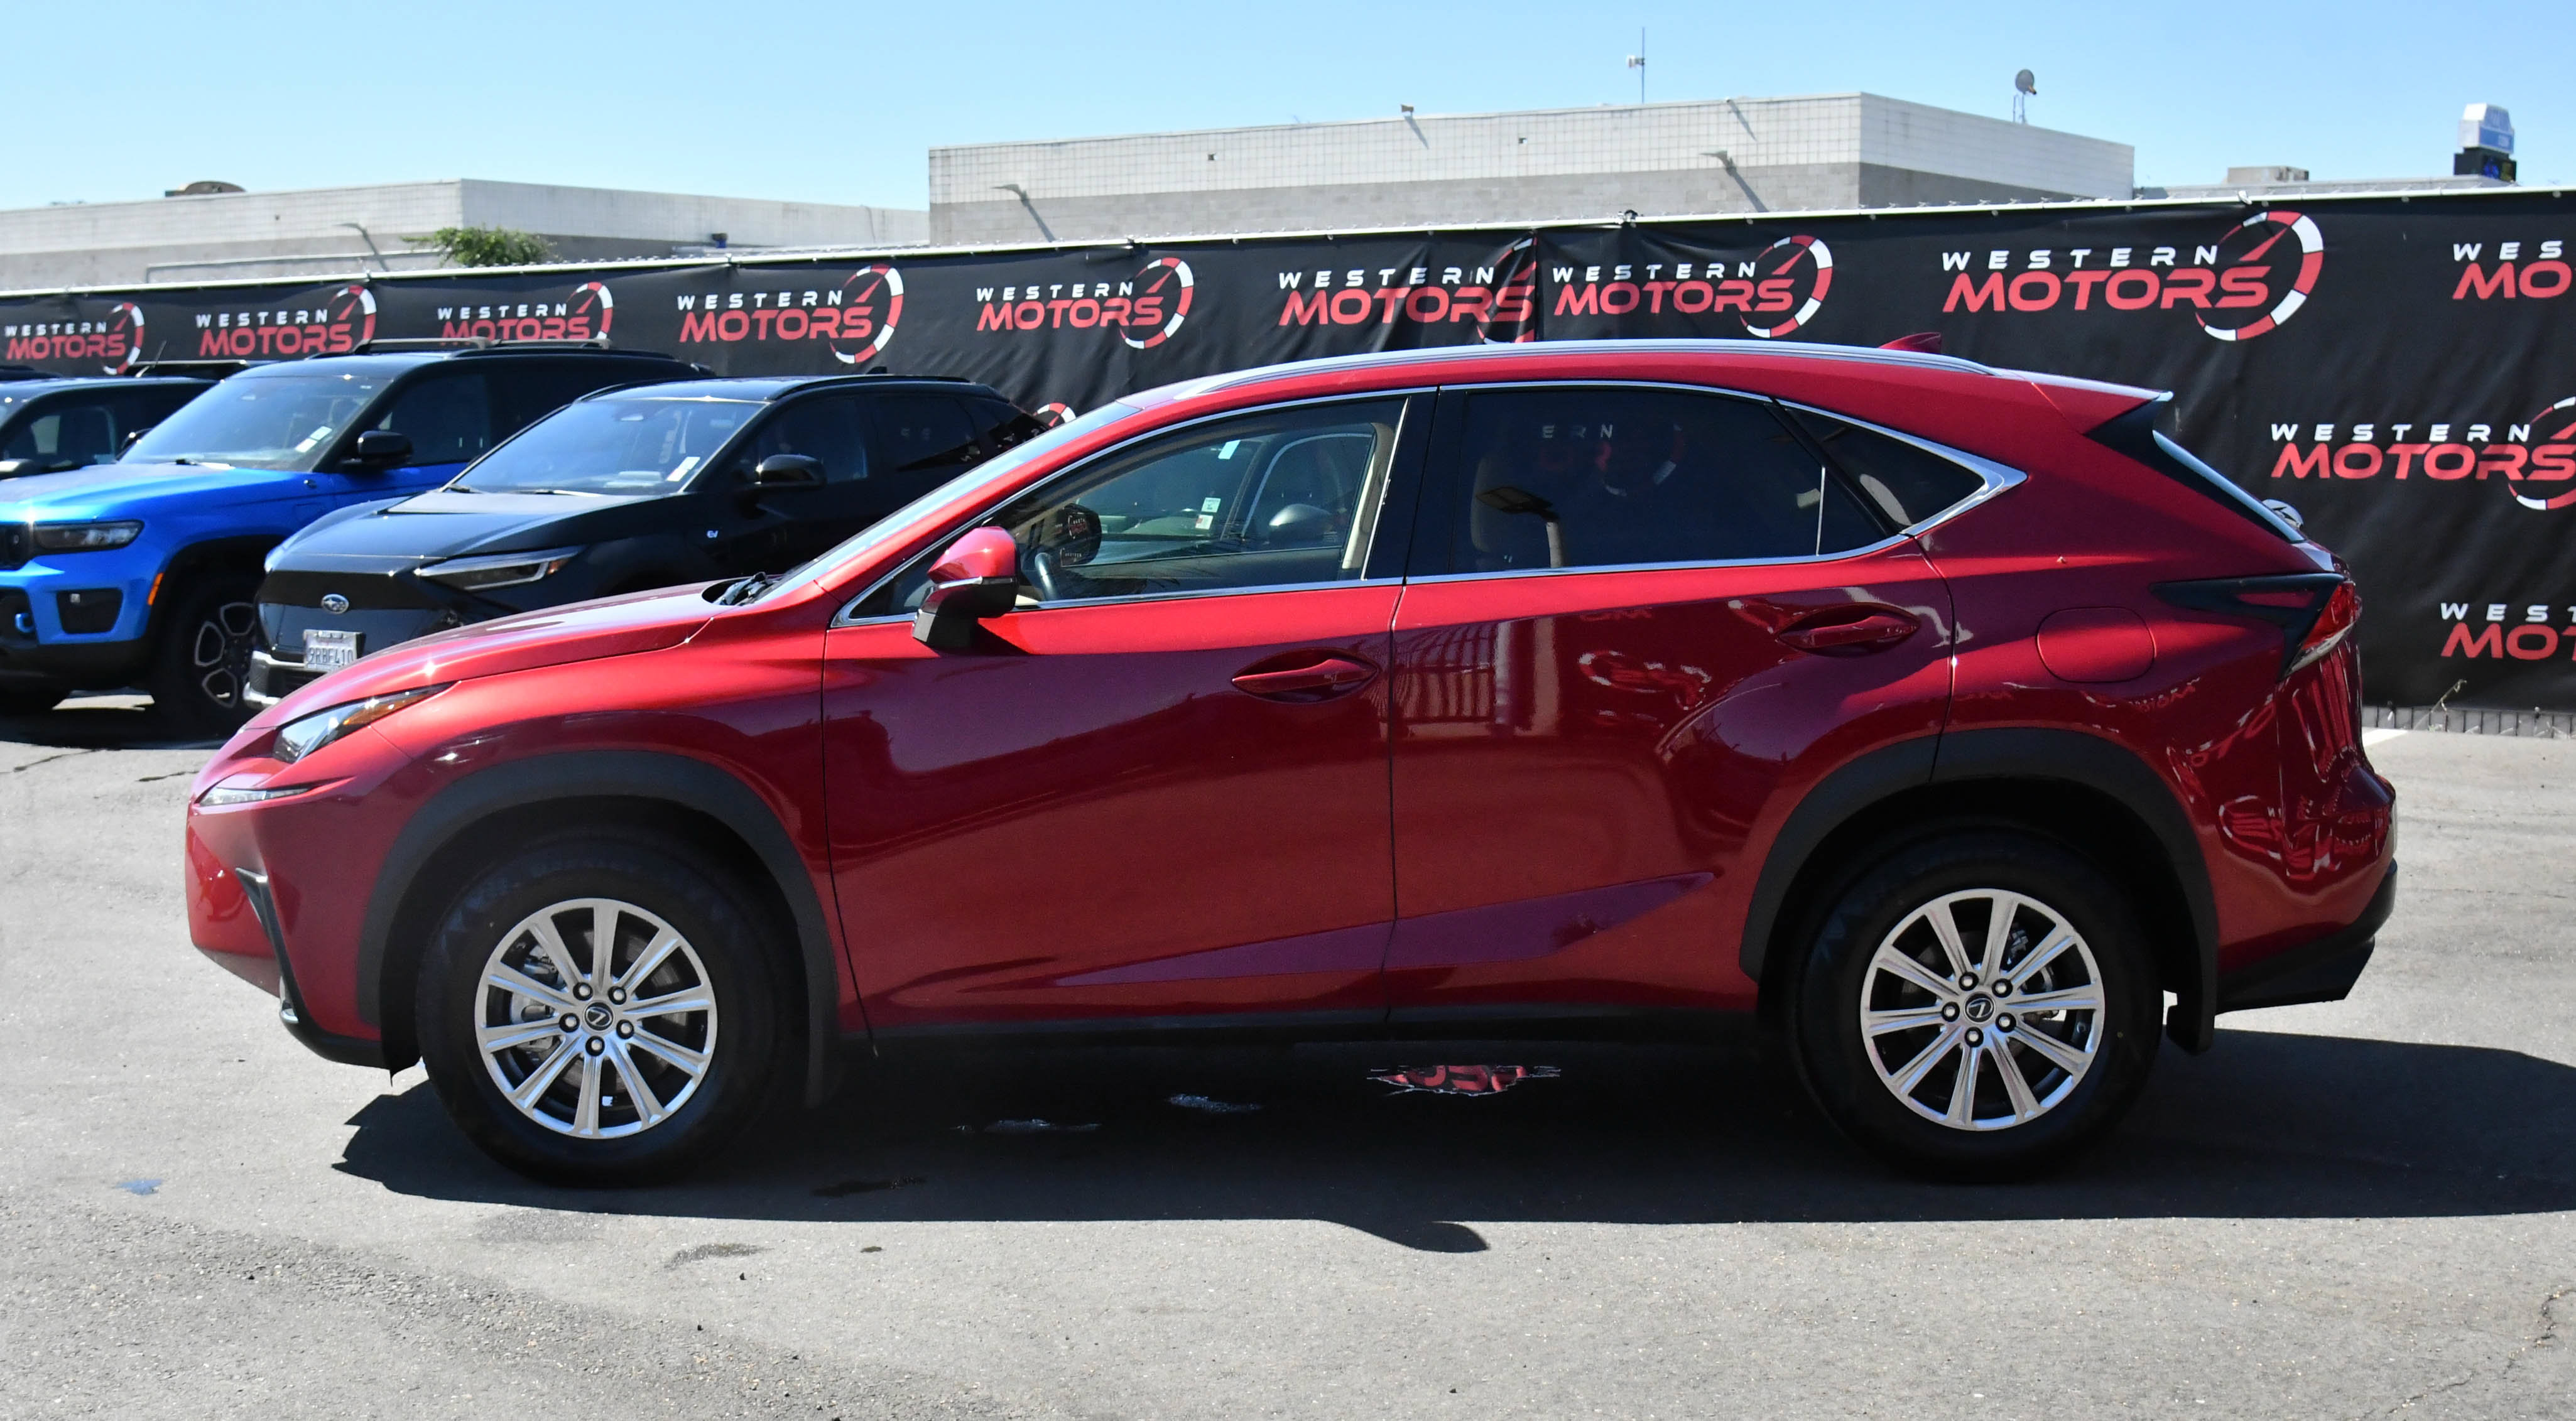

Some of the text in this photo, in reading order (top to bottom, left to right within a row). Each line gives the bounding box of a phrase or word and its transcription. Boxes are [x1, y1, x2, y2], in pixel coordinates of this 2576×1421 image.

[1942, 245, 2217, 271] WESTERN
[1279, 266, 1494, 289] WESTERN
[1553, 261, 1756, 283] WESTERN
[677, 289, 842, 311] WESTERN
[976, 281, 1133, 301] WESTERN
[1554, 278, 1795, 316] MOTORS
[1942, 266, 2271, 313] MOTORS
[196, 309, 328, 327] WESTERN
[438, 303, 567, 320] WESTERN
[977, 296, 1163, 331] MOTORS
[1279, 285, 1535, 326] MOTORS
[5, 322, 106, 337] WESTERN
[442, 316, 590, 345] MOTORS
[680, 306, 873, 343] MOTORS
[6, 333, 126, 360] MOTORS
[199, 323, 352, 356] MOTORS
[2271, 423, 2530, 442] WESTERN
[2271, 442, 2576, 481] MOTORS
